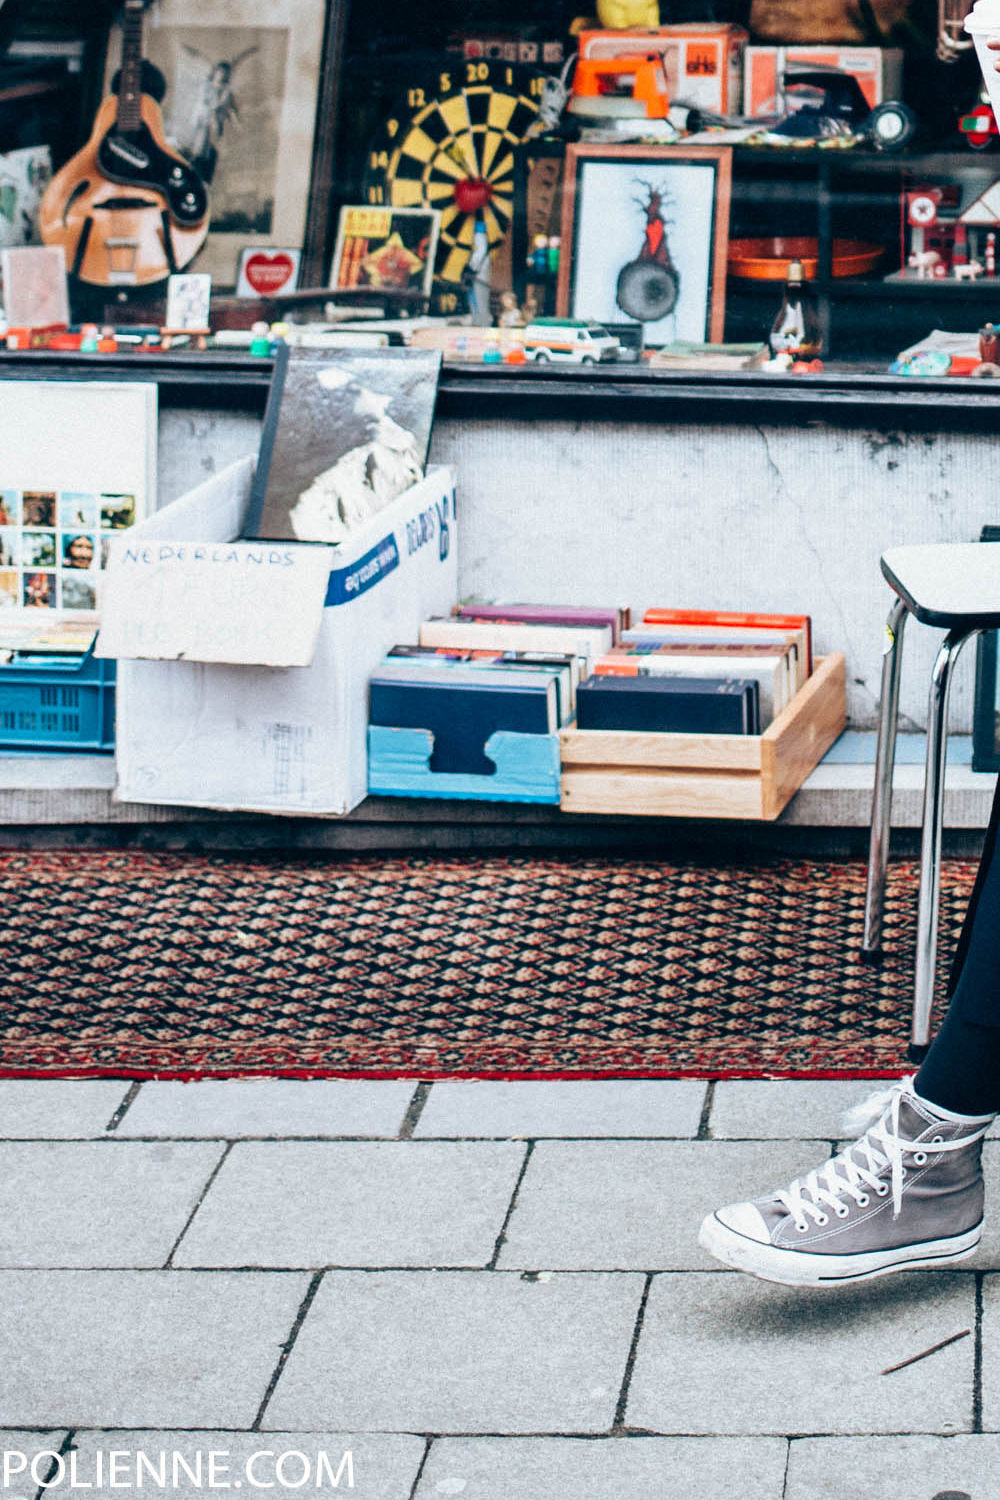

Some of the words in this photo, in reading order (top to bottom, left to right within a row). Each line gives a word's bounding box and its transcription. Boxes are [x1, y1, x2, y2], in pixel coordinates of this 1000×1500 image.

[466, 62, 489, 80] 20
[506, 67, 512, 85] 1
[440, 73, 450, 91] 5
[407, 88, 425, 107] 12
[387, 118, 398, 137] 9
[370, 151, 388, 170] 14
